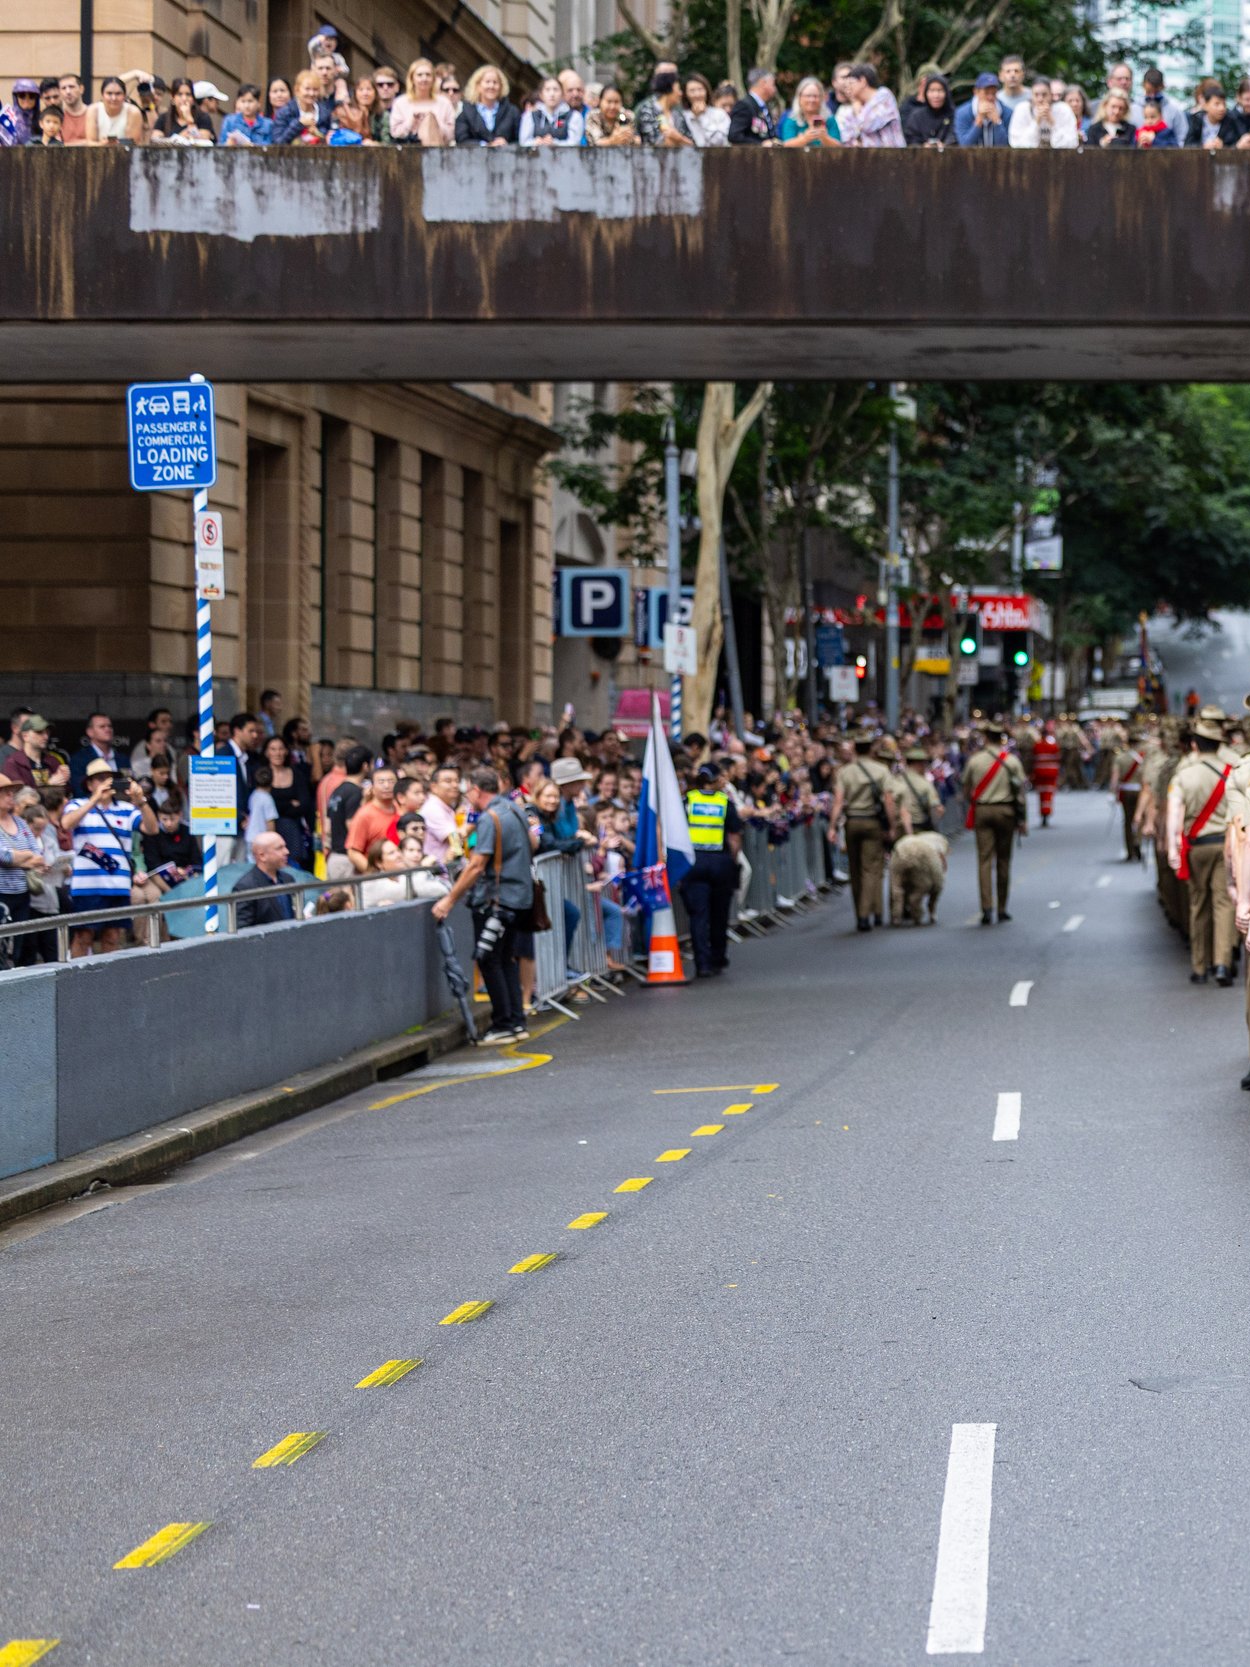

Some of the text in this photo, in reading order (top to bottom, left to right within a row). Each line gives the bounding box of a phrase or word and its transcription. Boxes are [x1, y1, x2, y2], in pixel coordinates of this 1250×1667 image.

[136, 420, 207, 434] PASSENGER &
[137, 434, 207, 447] COMMERCIAL
[137, 446, 208, 464] LOADING
[152, 465, 195, 481] ZONE
[580, 579, 617, 625] P
